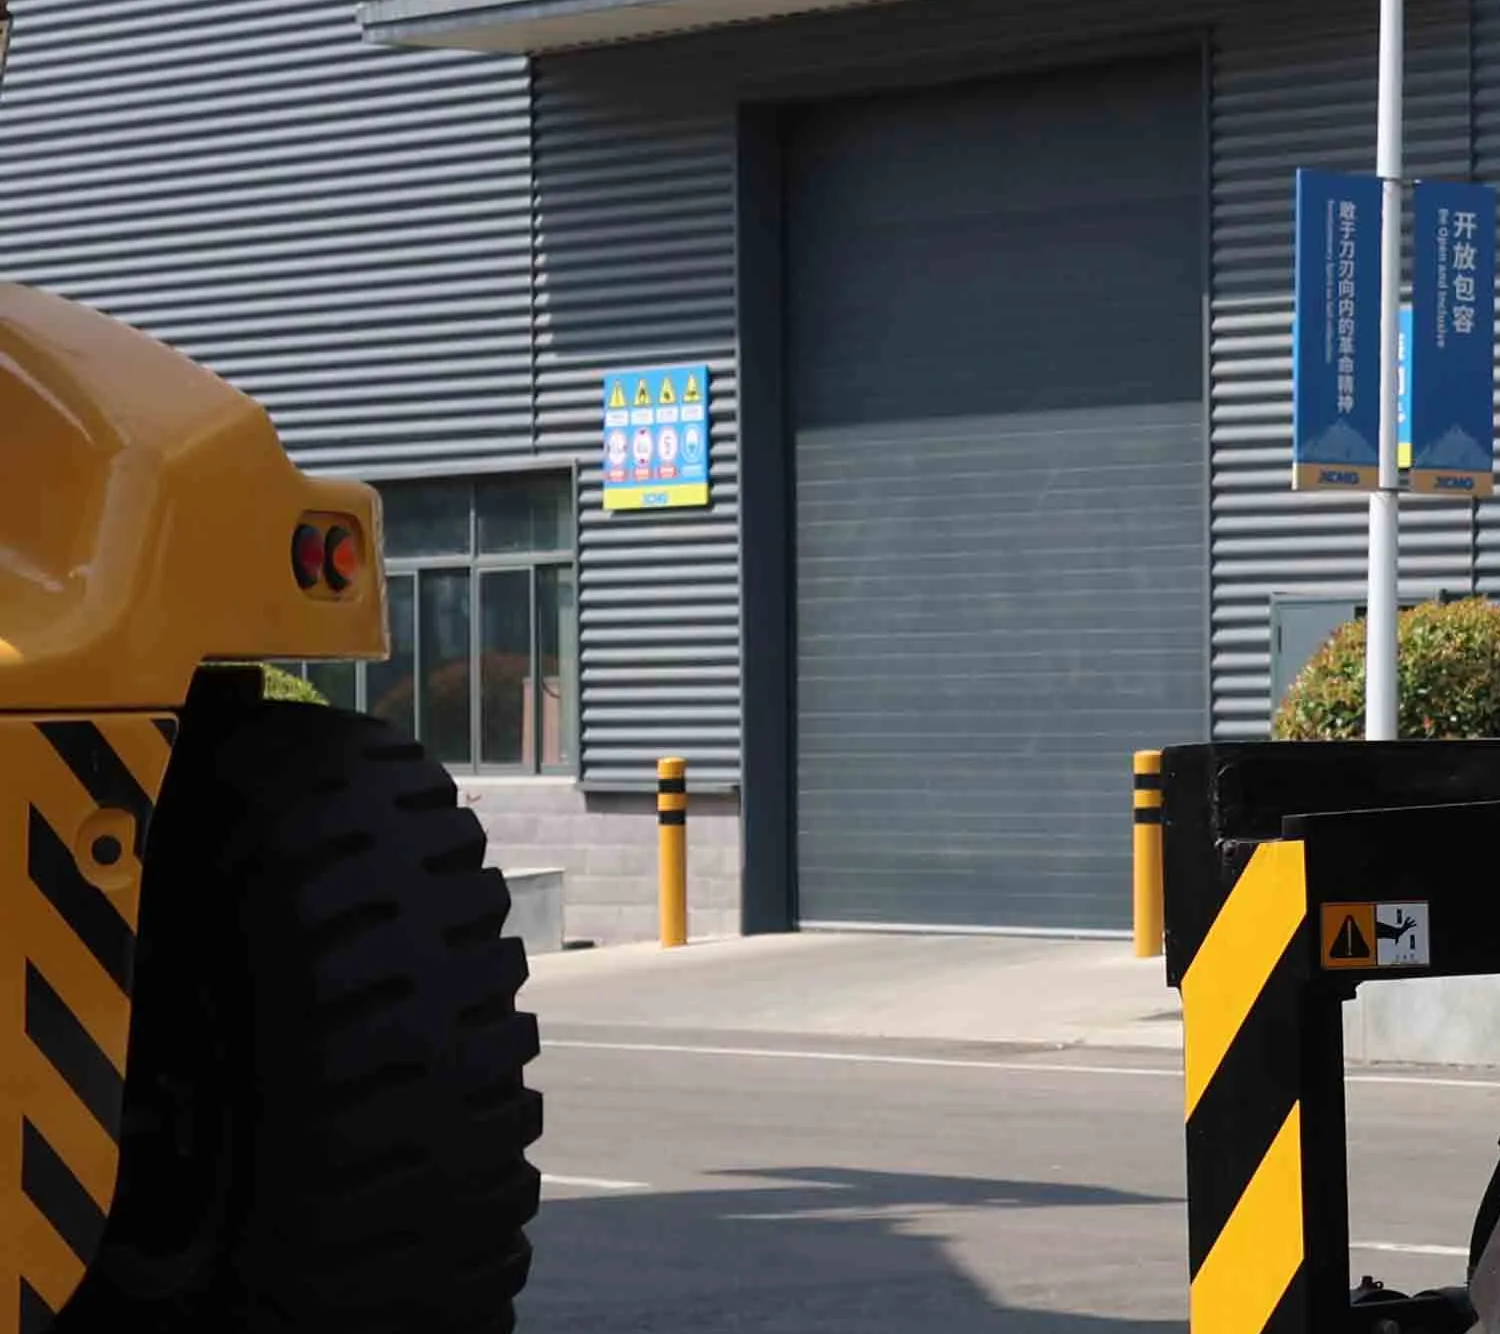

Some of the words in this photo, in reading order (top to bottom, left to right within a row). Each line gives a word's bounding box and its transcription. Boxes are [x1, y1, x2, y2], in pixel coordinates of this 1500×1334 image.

[1336, 200, 1356, 415] 敢于刀刃向内的革命精神
[1453, 210, 1478, 335] 开放包容
